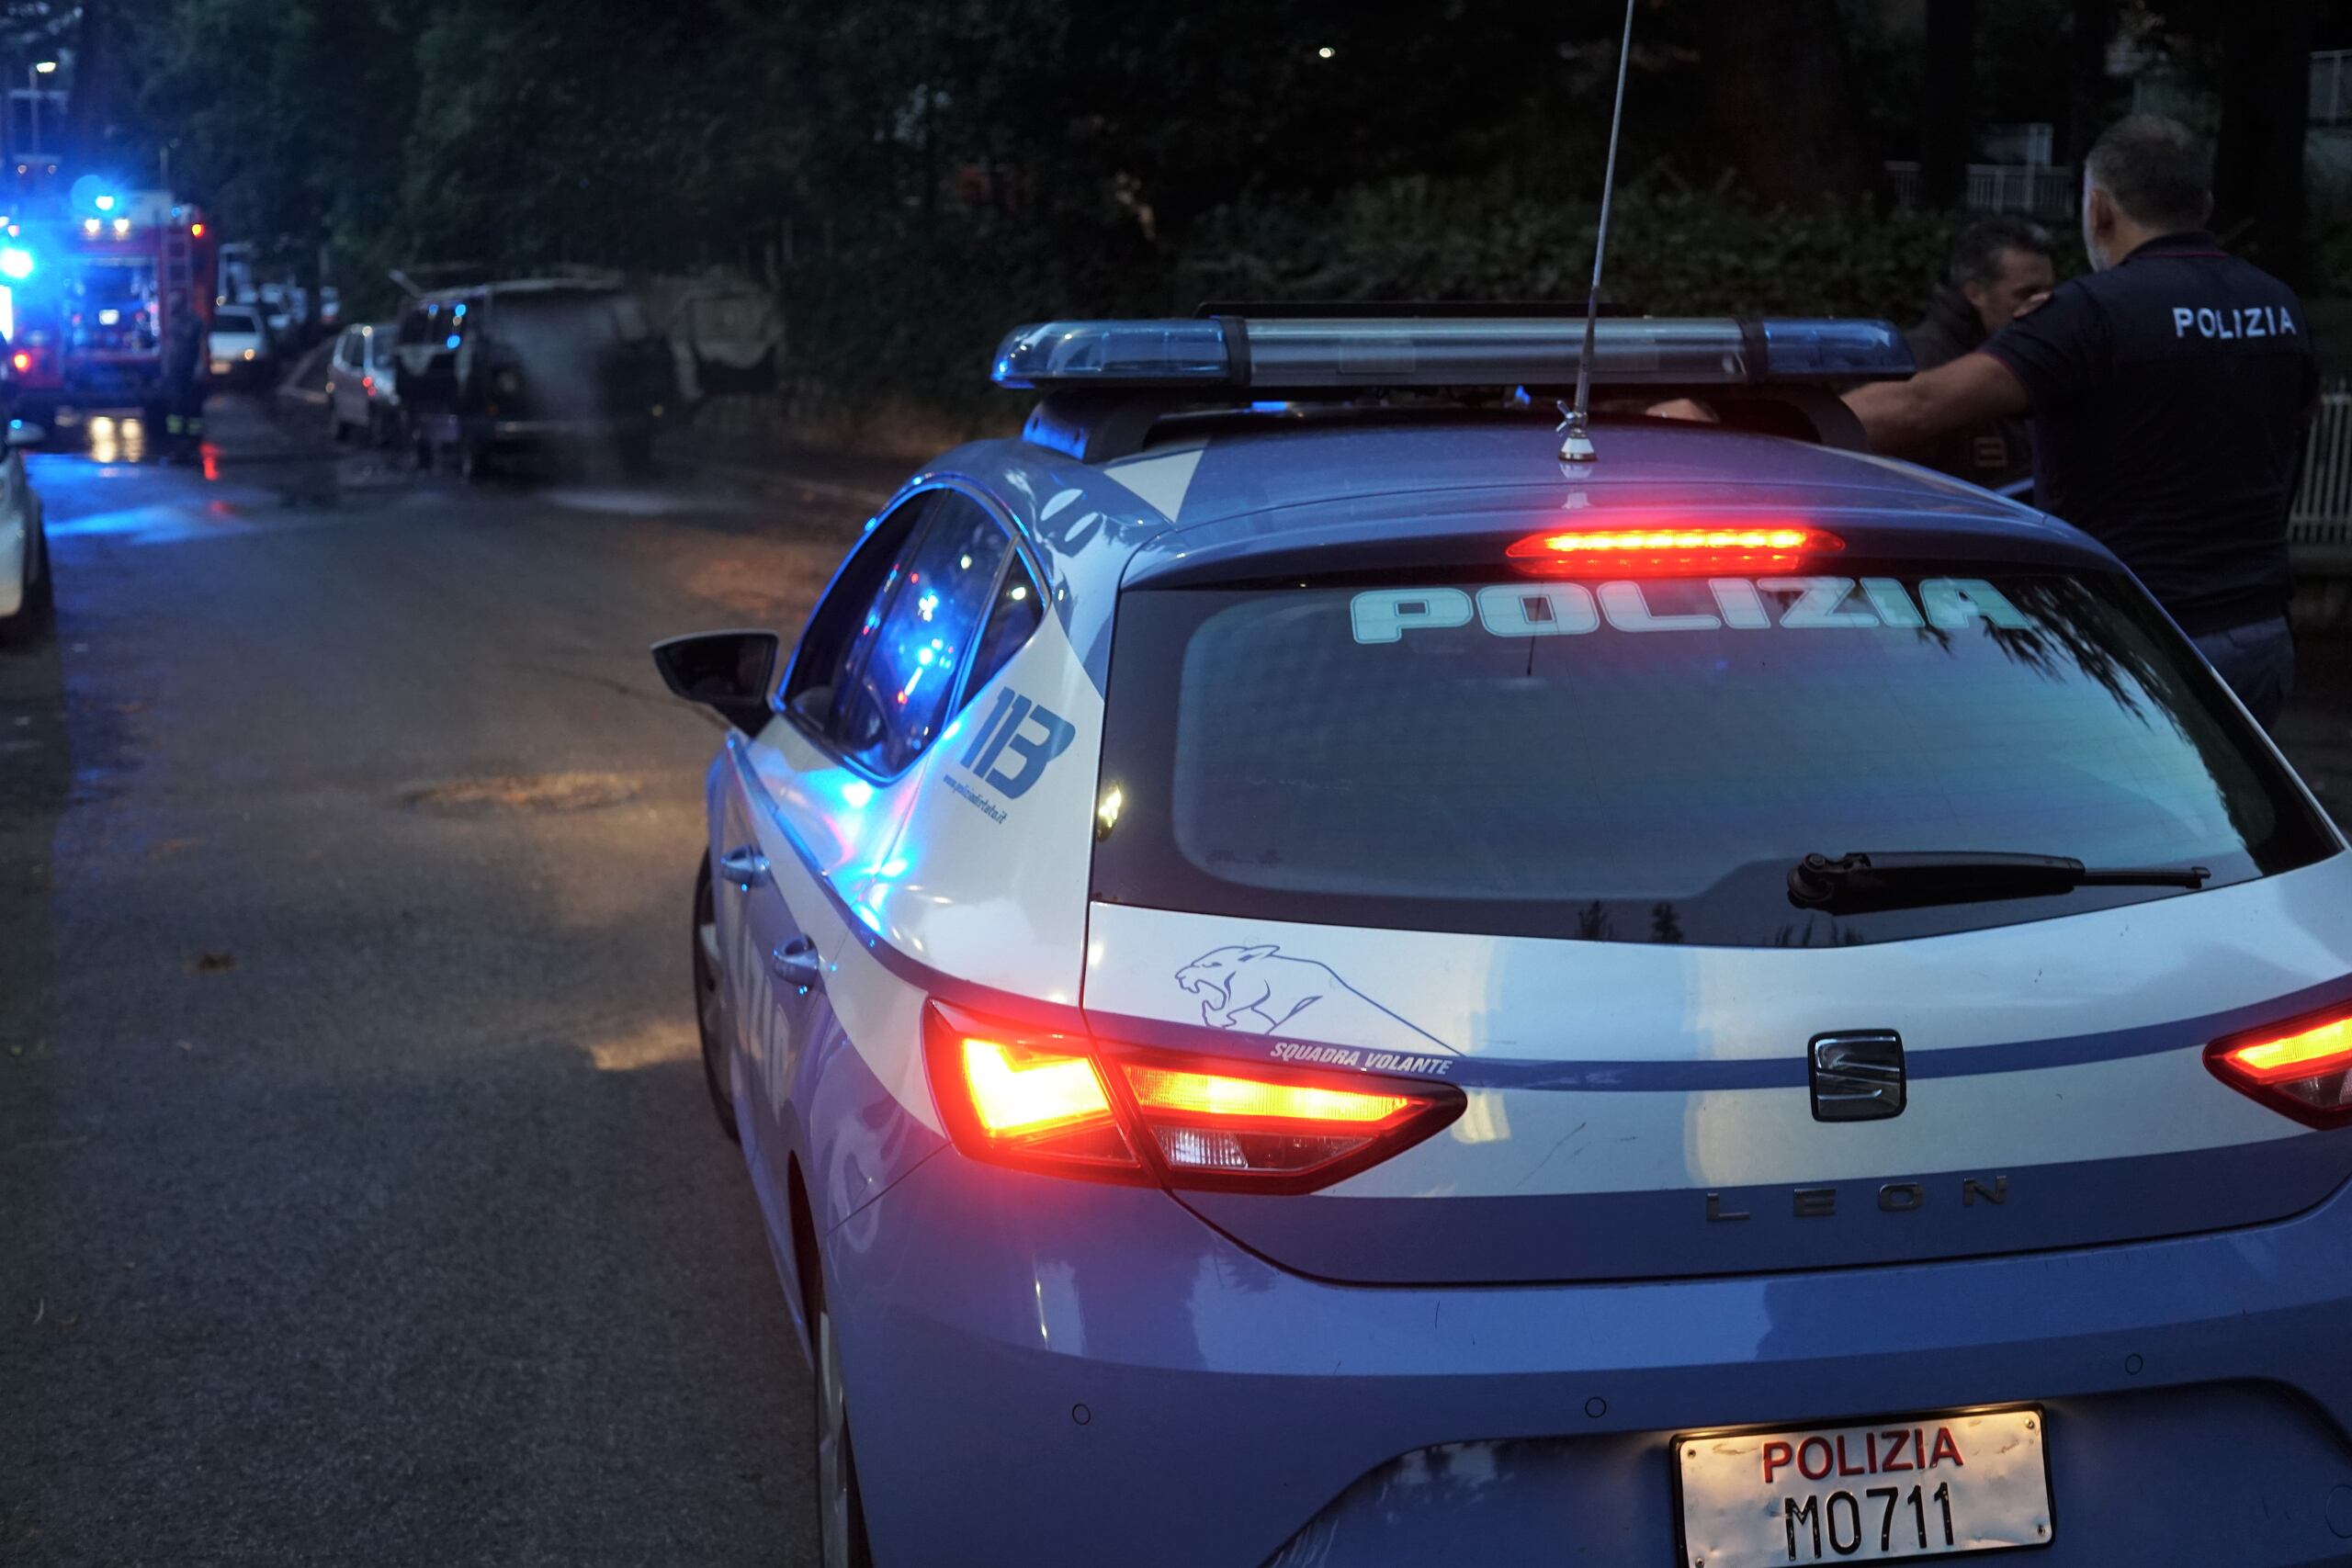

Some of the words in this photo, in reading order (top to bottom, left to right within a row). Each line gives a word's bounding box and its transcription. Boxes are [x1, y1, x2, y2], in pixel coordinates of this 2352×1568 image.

[2172, 306, 2297, 340] POLIZIA
[1351, 576, 2033, 644] POLIZIA
[960, 686, 1076, 799] 113
[1270, 1042, 1358, 1066] SQUADRA
[1363, 1051, 1453, 1076] VOLANTE
[1706, 1175, 2007, 1222] LEON
[1762, 1427, 1964, 1483] POLIZIA
